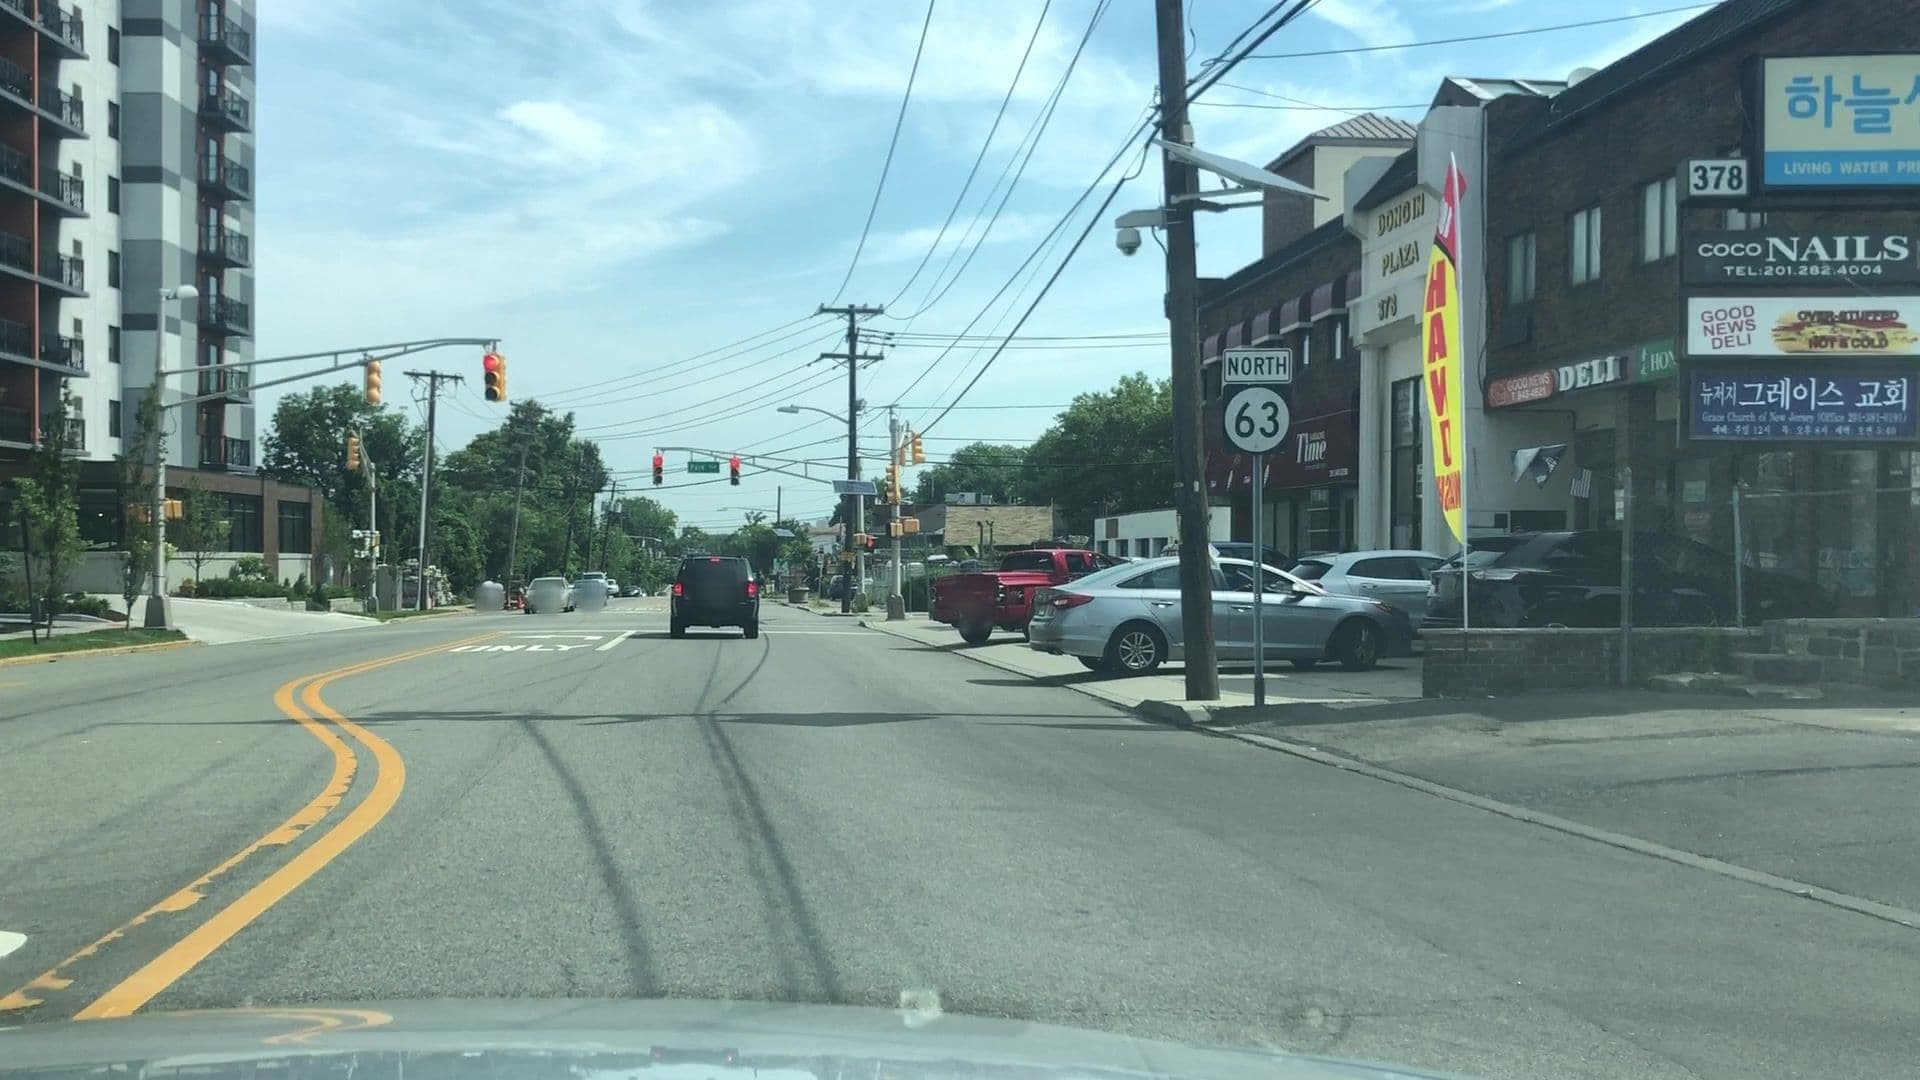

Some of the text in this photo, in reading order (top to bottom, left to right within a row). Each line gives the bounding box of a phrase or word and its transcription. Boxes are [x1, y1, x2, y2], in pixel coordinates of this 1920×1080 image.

[1784, 162, 1832, 175] LIVING
[1840, 161, 1888, 174] WATER
[1692, 166, 1743, 190] 378
[1382, 240, 1420, 277] PLAZA
[1698, 236, 1909, 262] COCO NAILS
[1723, 265, 1883, 277] TEL:201.282.4004
[1701, 305, 1755, 323] GOOD
[1704, 319, 1756, 337] NEWS
[1711, 333, 1752, 350] DELI
[1808, 335, 1836, 349] HOT
[1851, 335, 1889, 349] COLD
[1228, 356, 1287, 376] NORTH
[1559, 356, 1620, 391] DELI
[1507, 376, 1528, 392] GOOD
[1700, 376, 1909, 411] 뉴저지 그레이스 교회
[1235, 401, 1280, 438] 63
[1296, 431, 1327, 463] Time
[449, 643, 594, 651] ONLY
